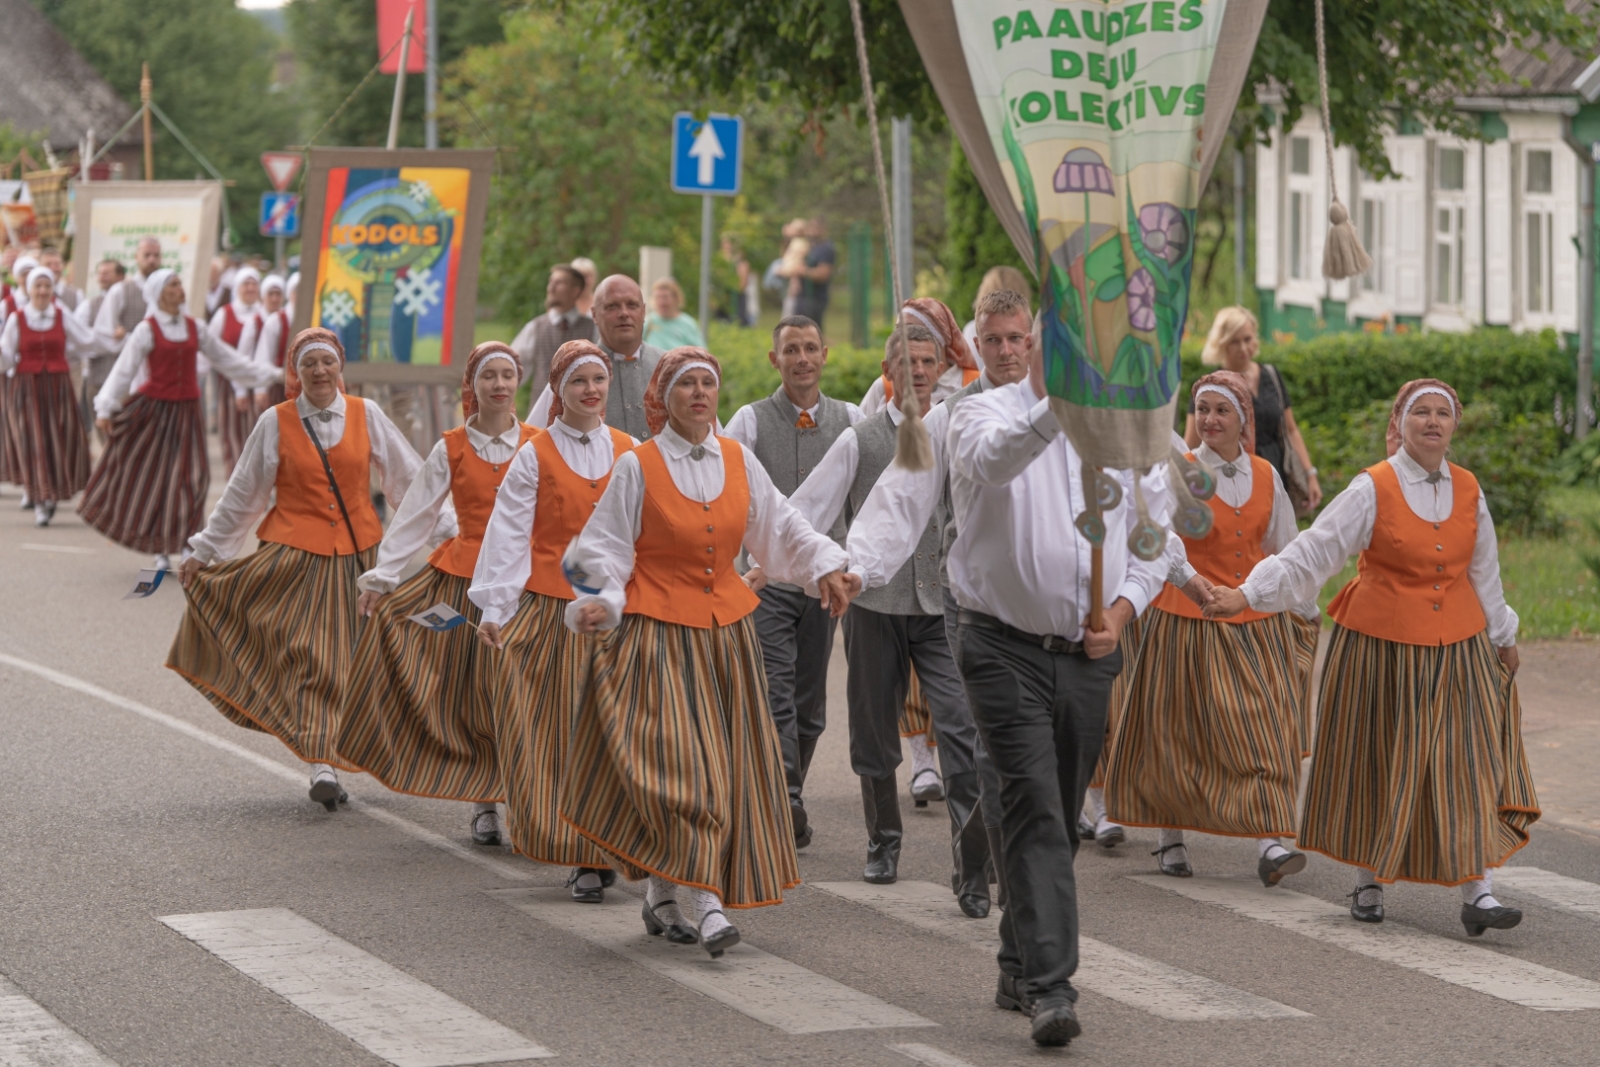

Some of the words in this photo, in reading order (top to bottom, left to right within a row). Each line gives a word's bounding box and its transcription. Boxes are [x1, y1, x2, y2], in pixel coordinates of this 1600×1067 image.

[992, 0, 1204, 51] PAAUDZES
[1050, 48, 1136, 90] DEJU
[332, 223, 439, 246] KODOLS
